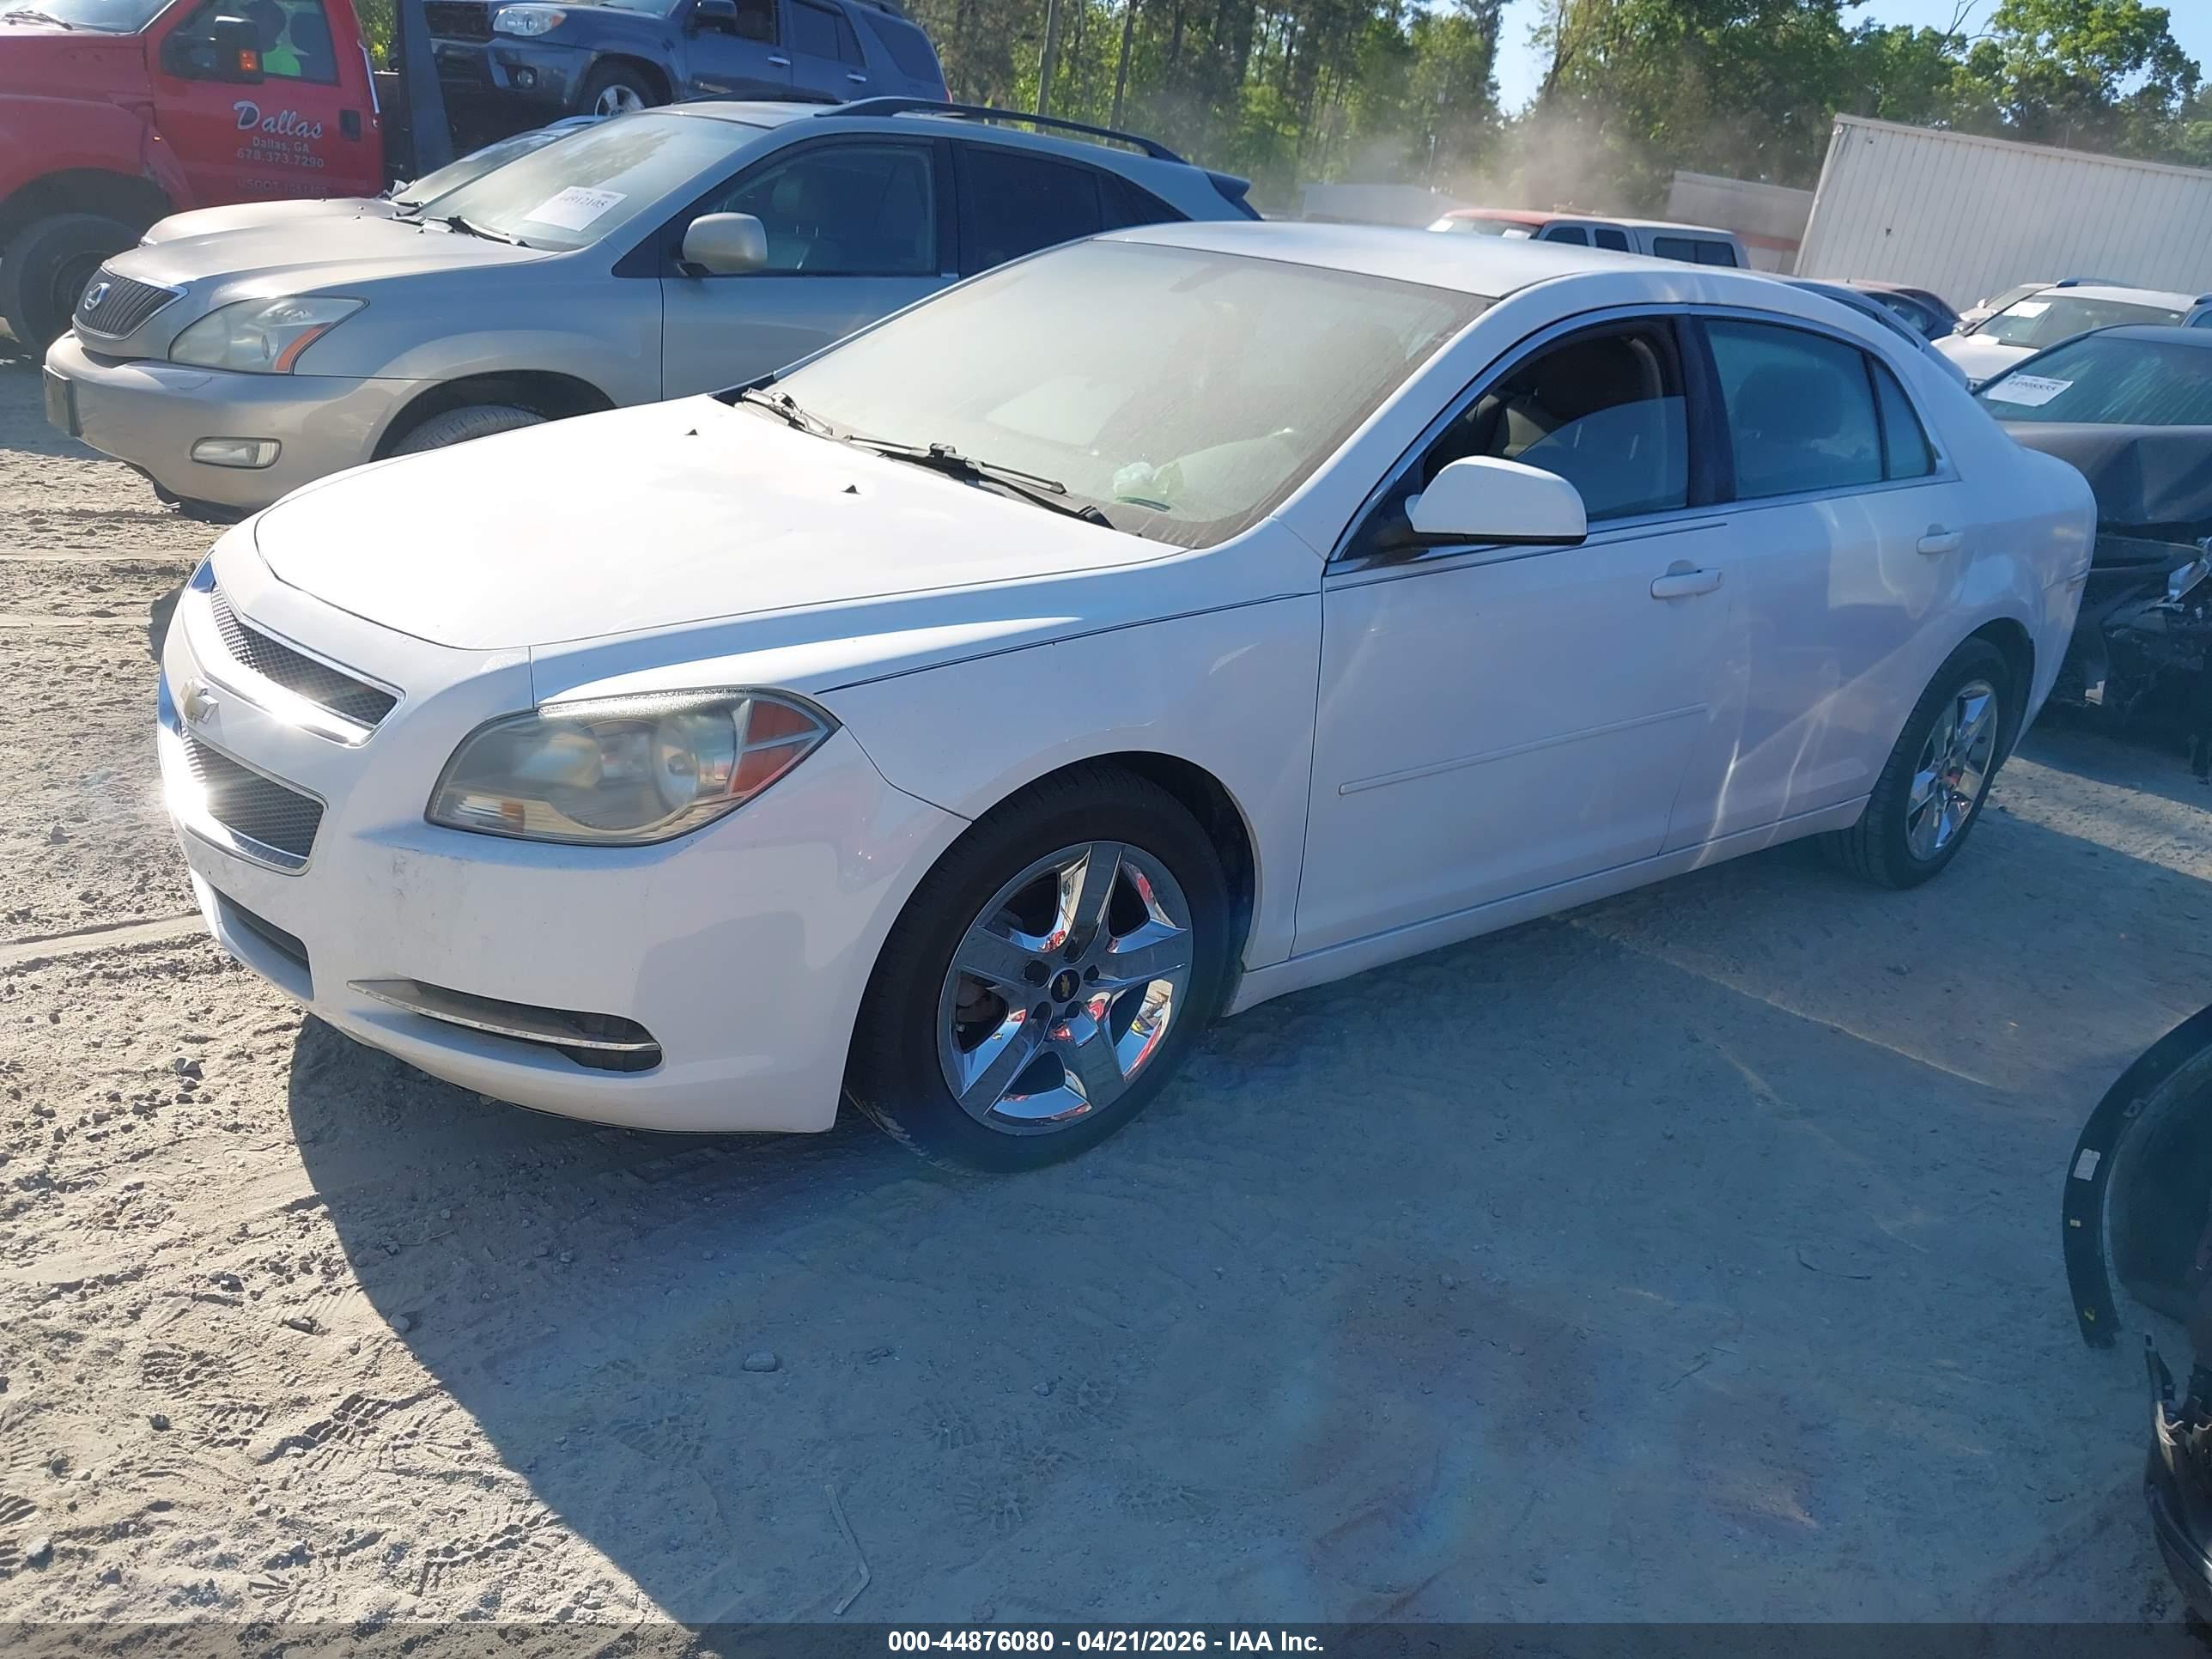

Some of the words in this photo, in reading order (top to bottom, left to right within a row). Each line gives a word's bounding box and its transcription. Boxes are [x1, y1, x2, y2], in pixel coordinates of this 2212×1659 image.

[234, 100, 323, 138] Dallas
[252, 137, 290, 153] Dallas,
[294, 141, 310, 154] GA
